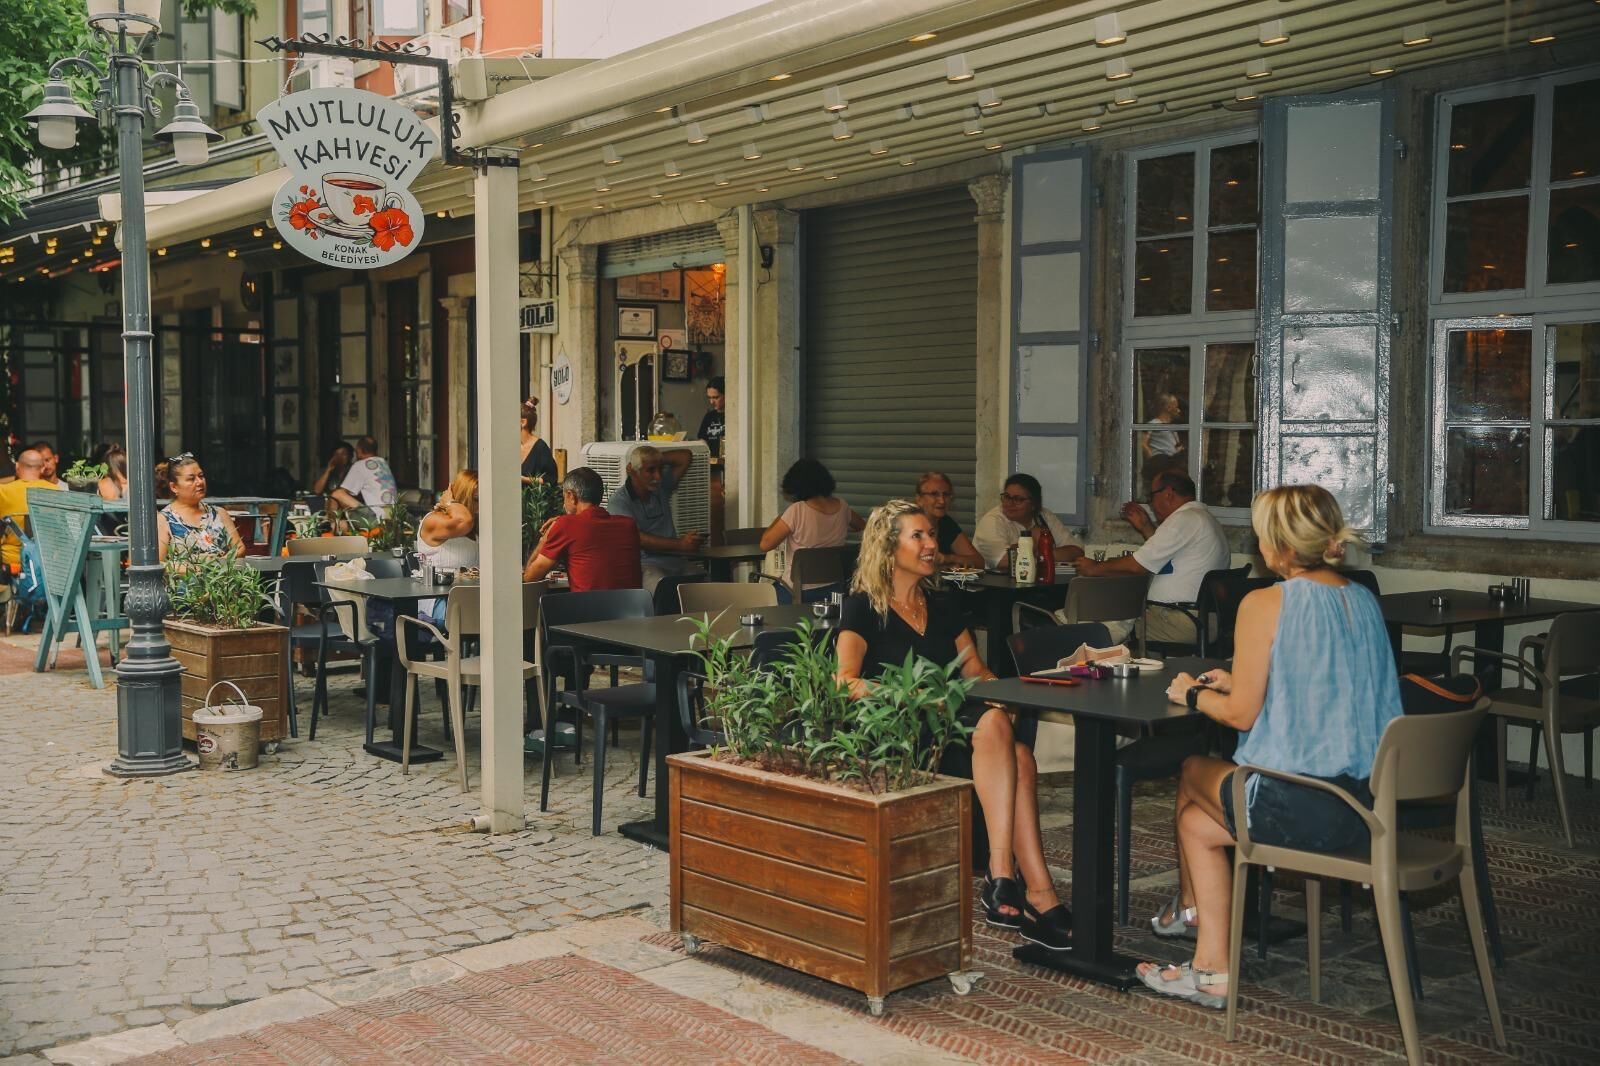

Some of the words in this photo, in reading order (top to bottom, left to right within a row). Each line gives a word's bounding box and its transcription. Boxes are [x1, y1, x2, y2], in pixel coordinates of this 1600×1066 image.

[268, 100, 432, 158] MUTLULUK
[294, 138, 412, 180] KAHVESİ
[321, 251, 380, 264] BELEDİYESİ
[334, 244, 368, 254] KONAK
[553, 366, 569, 387] YOLO
